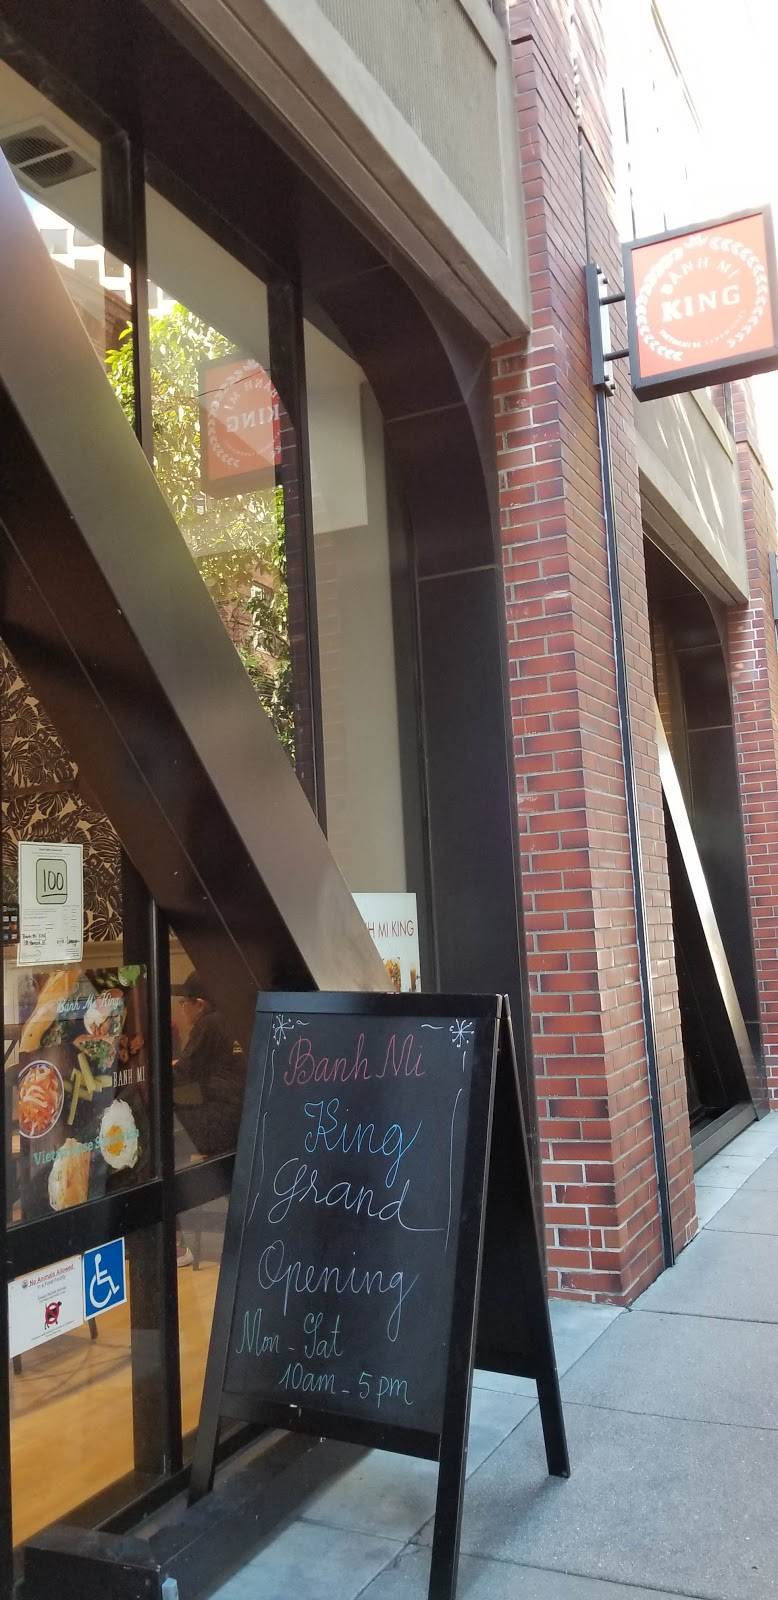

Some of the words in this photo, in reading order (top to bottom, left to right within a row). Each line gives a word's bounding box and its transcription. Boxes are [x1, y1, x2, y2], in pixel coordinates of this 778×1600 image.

[661, 284, 741, 322] KING
[43, 869, 64, 892] 100
[378, 921, 389, 937] MI
[391, 920, 415, 937] KING
[113, 1068, 133, 1088] BANH
[137, 1065, 145, 1082] MI
[284, 1033, 371, 1085] Banh
[376, 1034, 425, 1078] Mi
[304, 1097, 422, 1188] King
[268, 1157, 447, 1231] Grand
[258, 1239, 420, 1342] Opening
[236, 1308, 280, 1356] Mon
[303, 1312, 343, 1359] Sat
[278, 1363, 336, 1395] 10am
[359, 1370, 374, 1400] 5
[377, 1375, 415, 1409] pm
